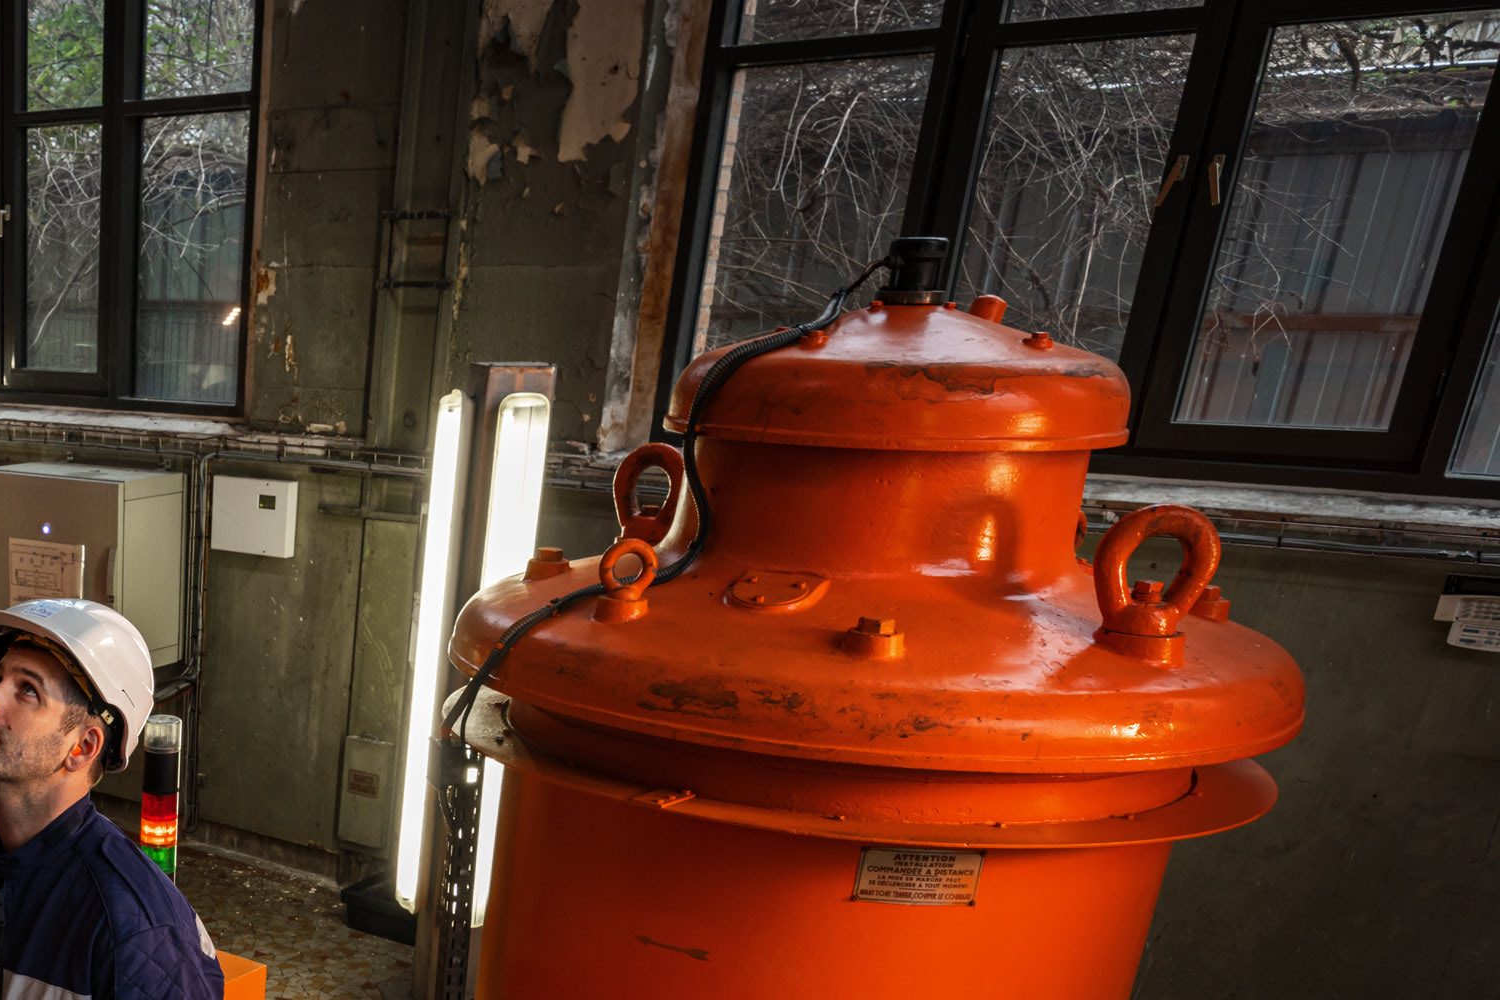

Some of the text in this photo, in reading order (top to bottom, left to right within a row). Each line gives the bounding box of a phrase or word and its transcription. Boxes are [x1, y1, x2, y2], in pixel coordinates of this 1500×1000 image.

[893, 853, 956, 862] ATTENTION
[867, 864, 922, 875] COMMANDÉE
[934, 868, 975, 876] DISTANCE
